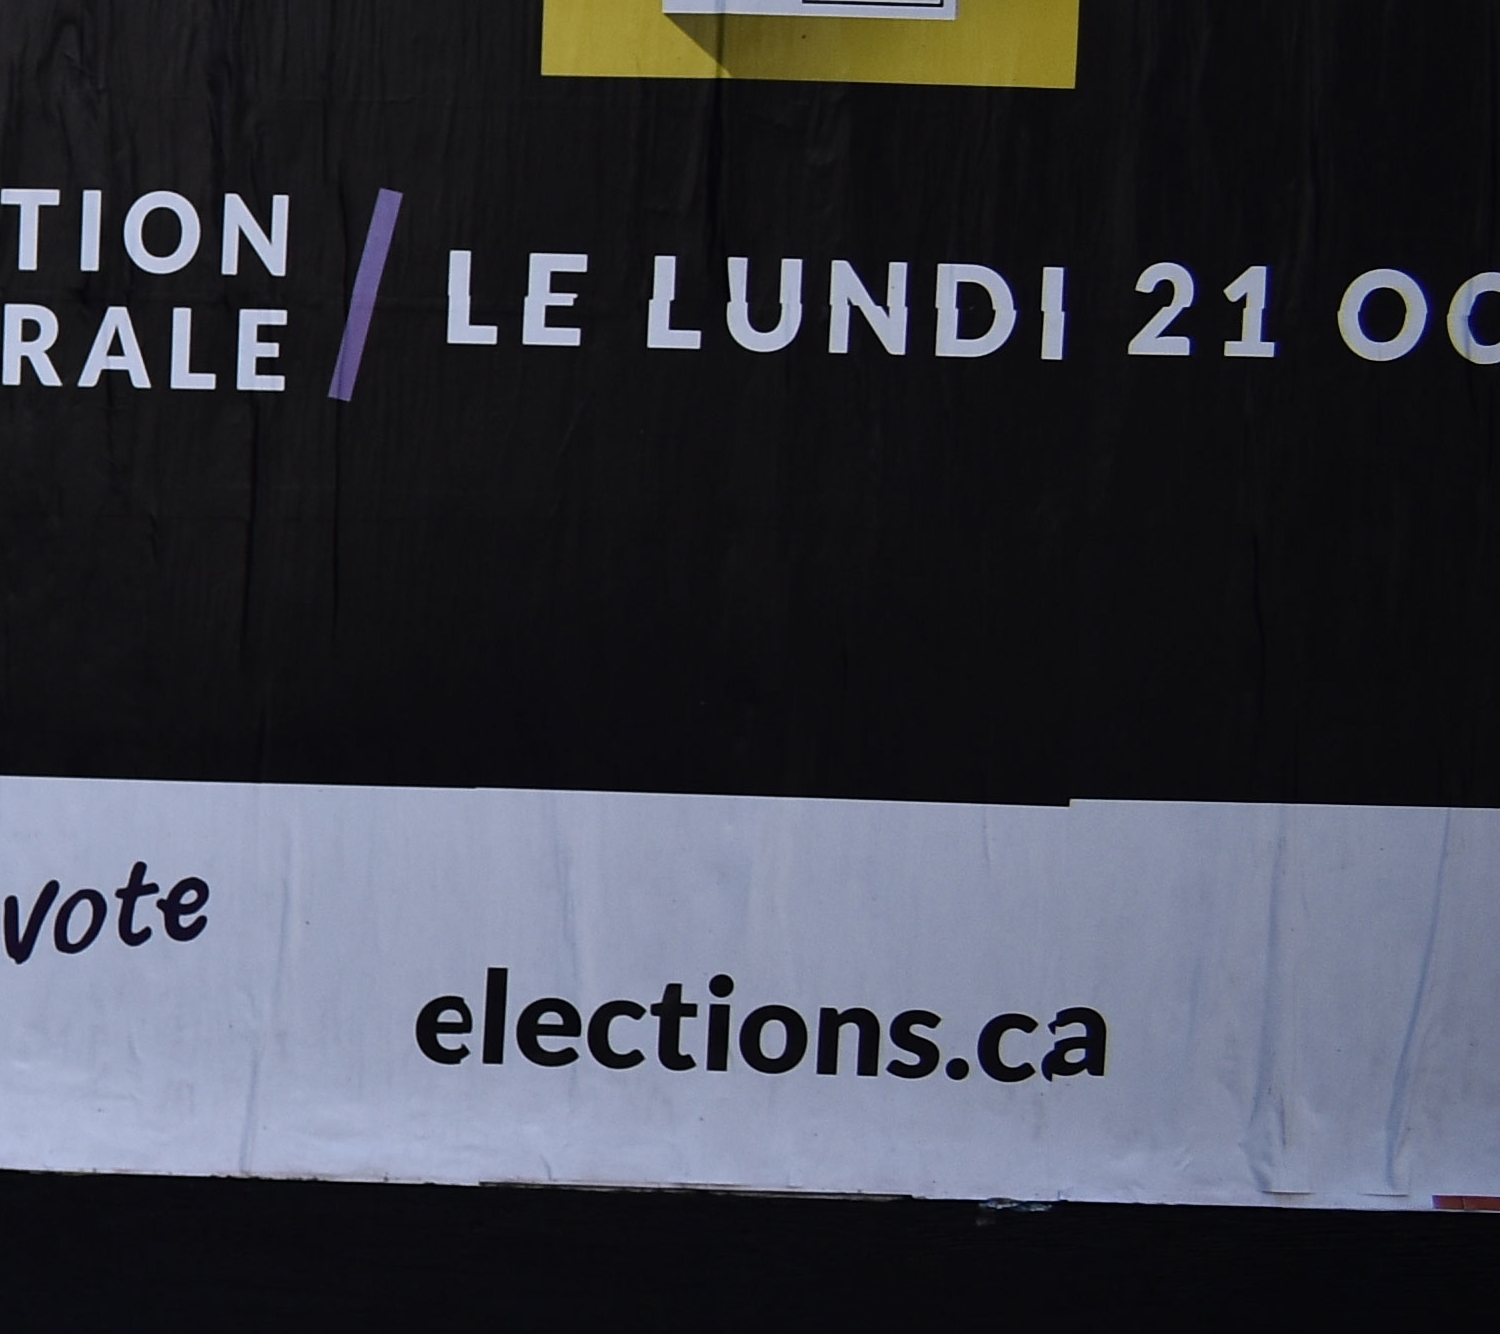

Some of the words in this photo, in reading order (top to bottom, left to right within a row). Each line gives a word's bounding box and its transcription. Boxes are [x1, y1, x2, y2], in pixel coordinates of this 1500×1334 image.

[446, 249, 589, 346] LE
[646, 255, 1067, 361] LUNDI
[1127, 261, 1278, 360] 21
[414, 967, 1110, 1085] elections.ca
